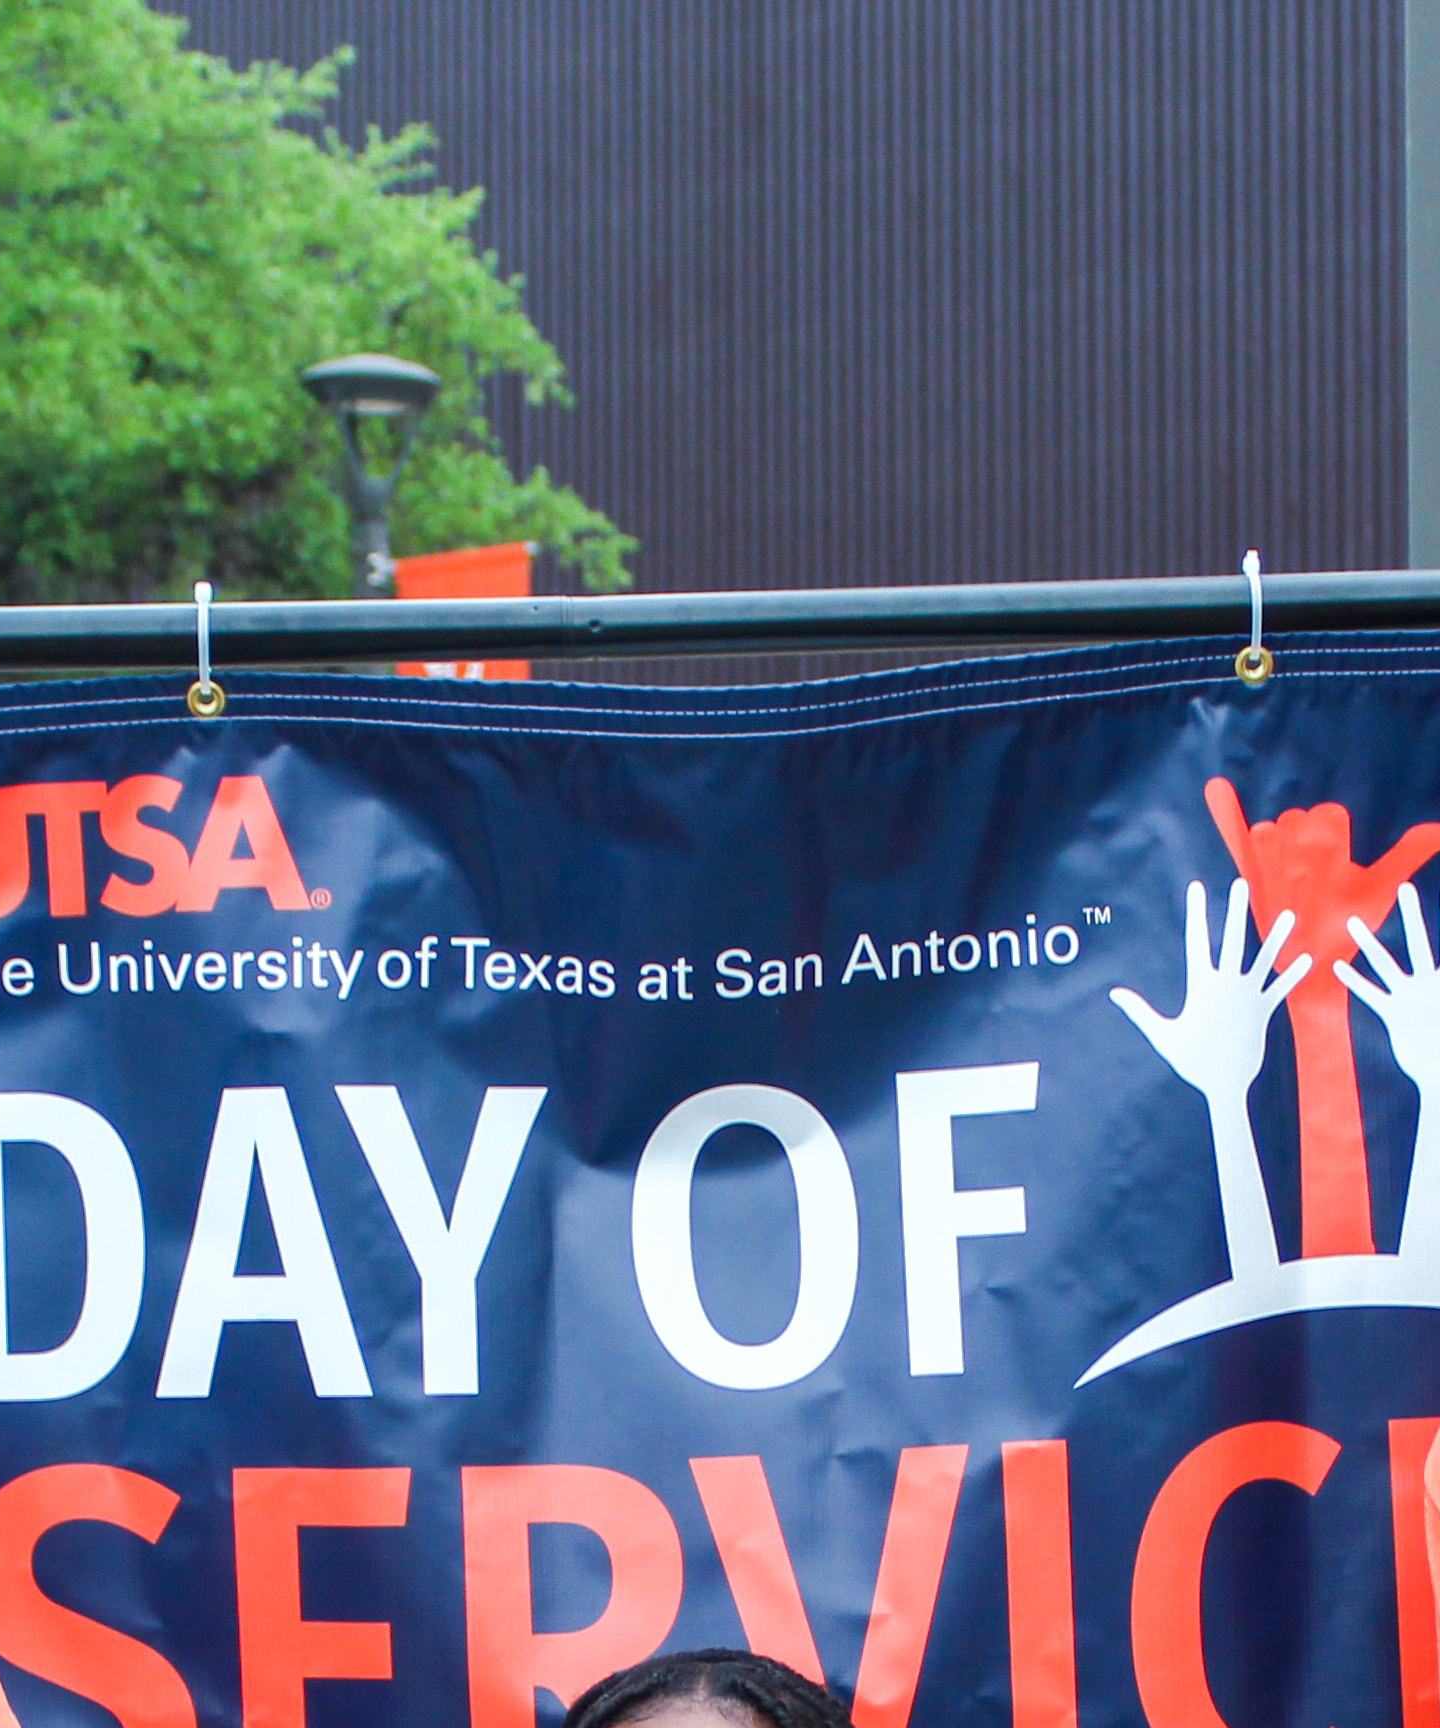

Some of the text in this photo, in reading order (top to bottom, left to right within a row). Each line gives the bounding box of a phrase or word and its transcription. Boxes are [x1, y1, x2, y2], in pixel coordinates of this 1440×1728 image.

[57, 937, 364, 1000] University
[378, 935, 438, 990] of
[450, 937, 617, 999] Texas
[637, 957, 694, 1001] at
[713, 949, 824, 998] San
[631, 1061, 1040, 1391] OF
